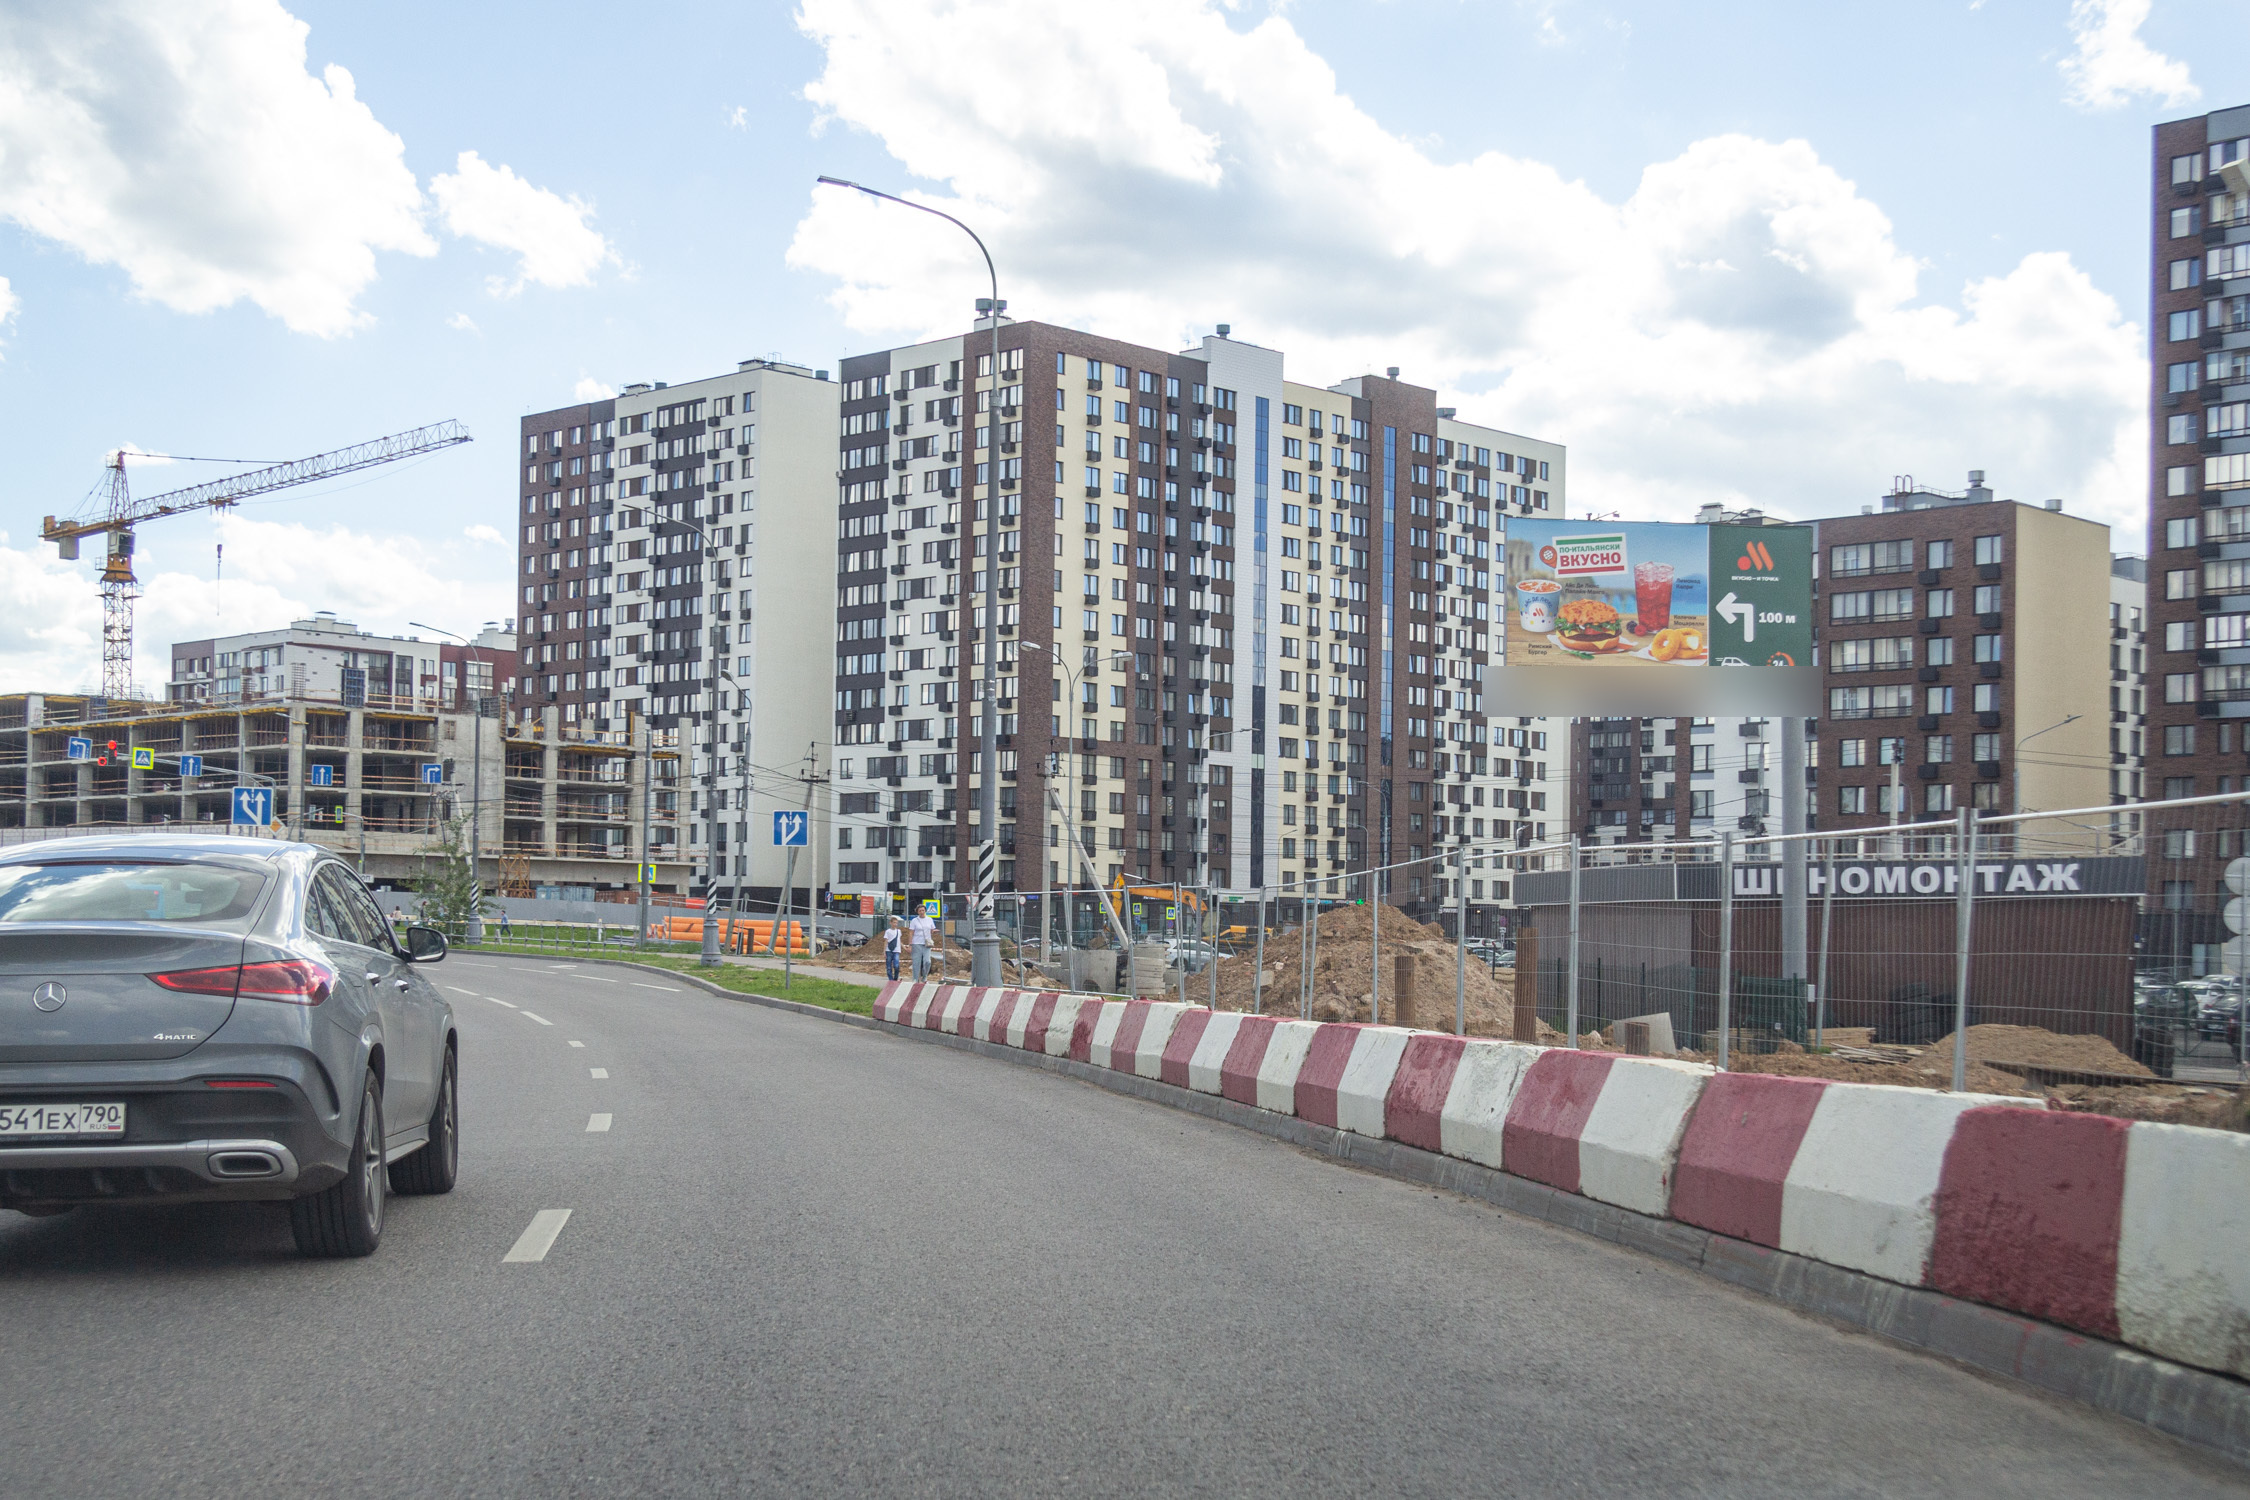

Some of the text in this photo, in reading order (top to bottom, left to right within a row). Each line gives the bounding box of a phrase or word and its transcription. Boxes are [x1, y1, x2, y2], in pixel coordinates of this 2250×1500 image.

[1559, 543, 1621, 554] ПО-ИТАЛЬЯНСКИ
[1559, 552, 1622, 567] ВКУСНО
[1758, 612, 1783, 624] 100
[153, 1033, 197, 1041] 4MATIC
[82, 1105, 119, 1123] 790
